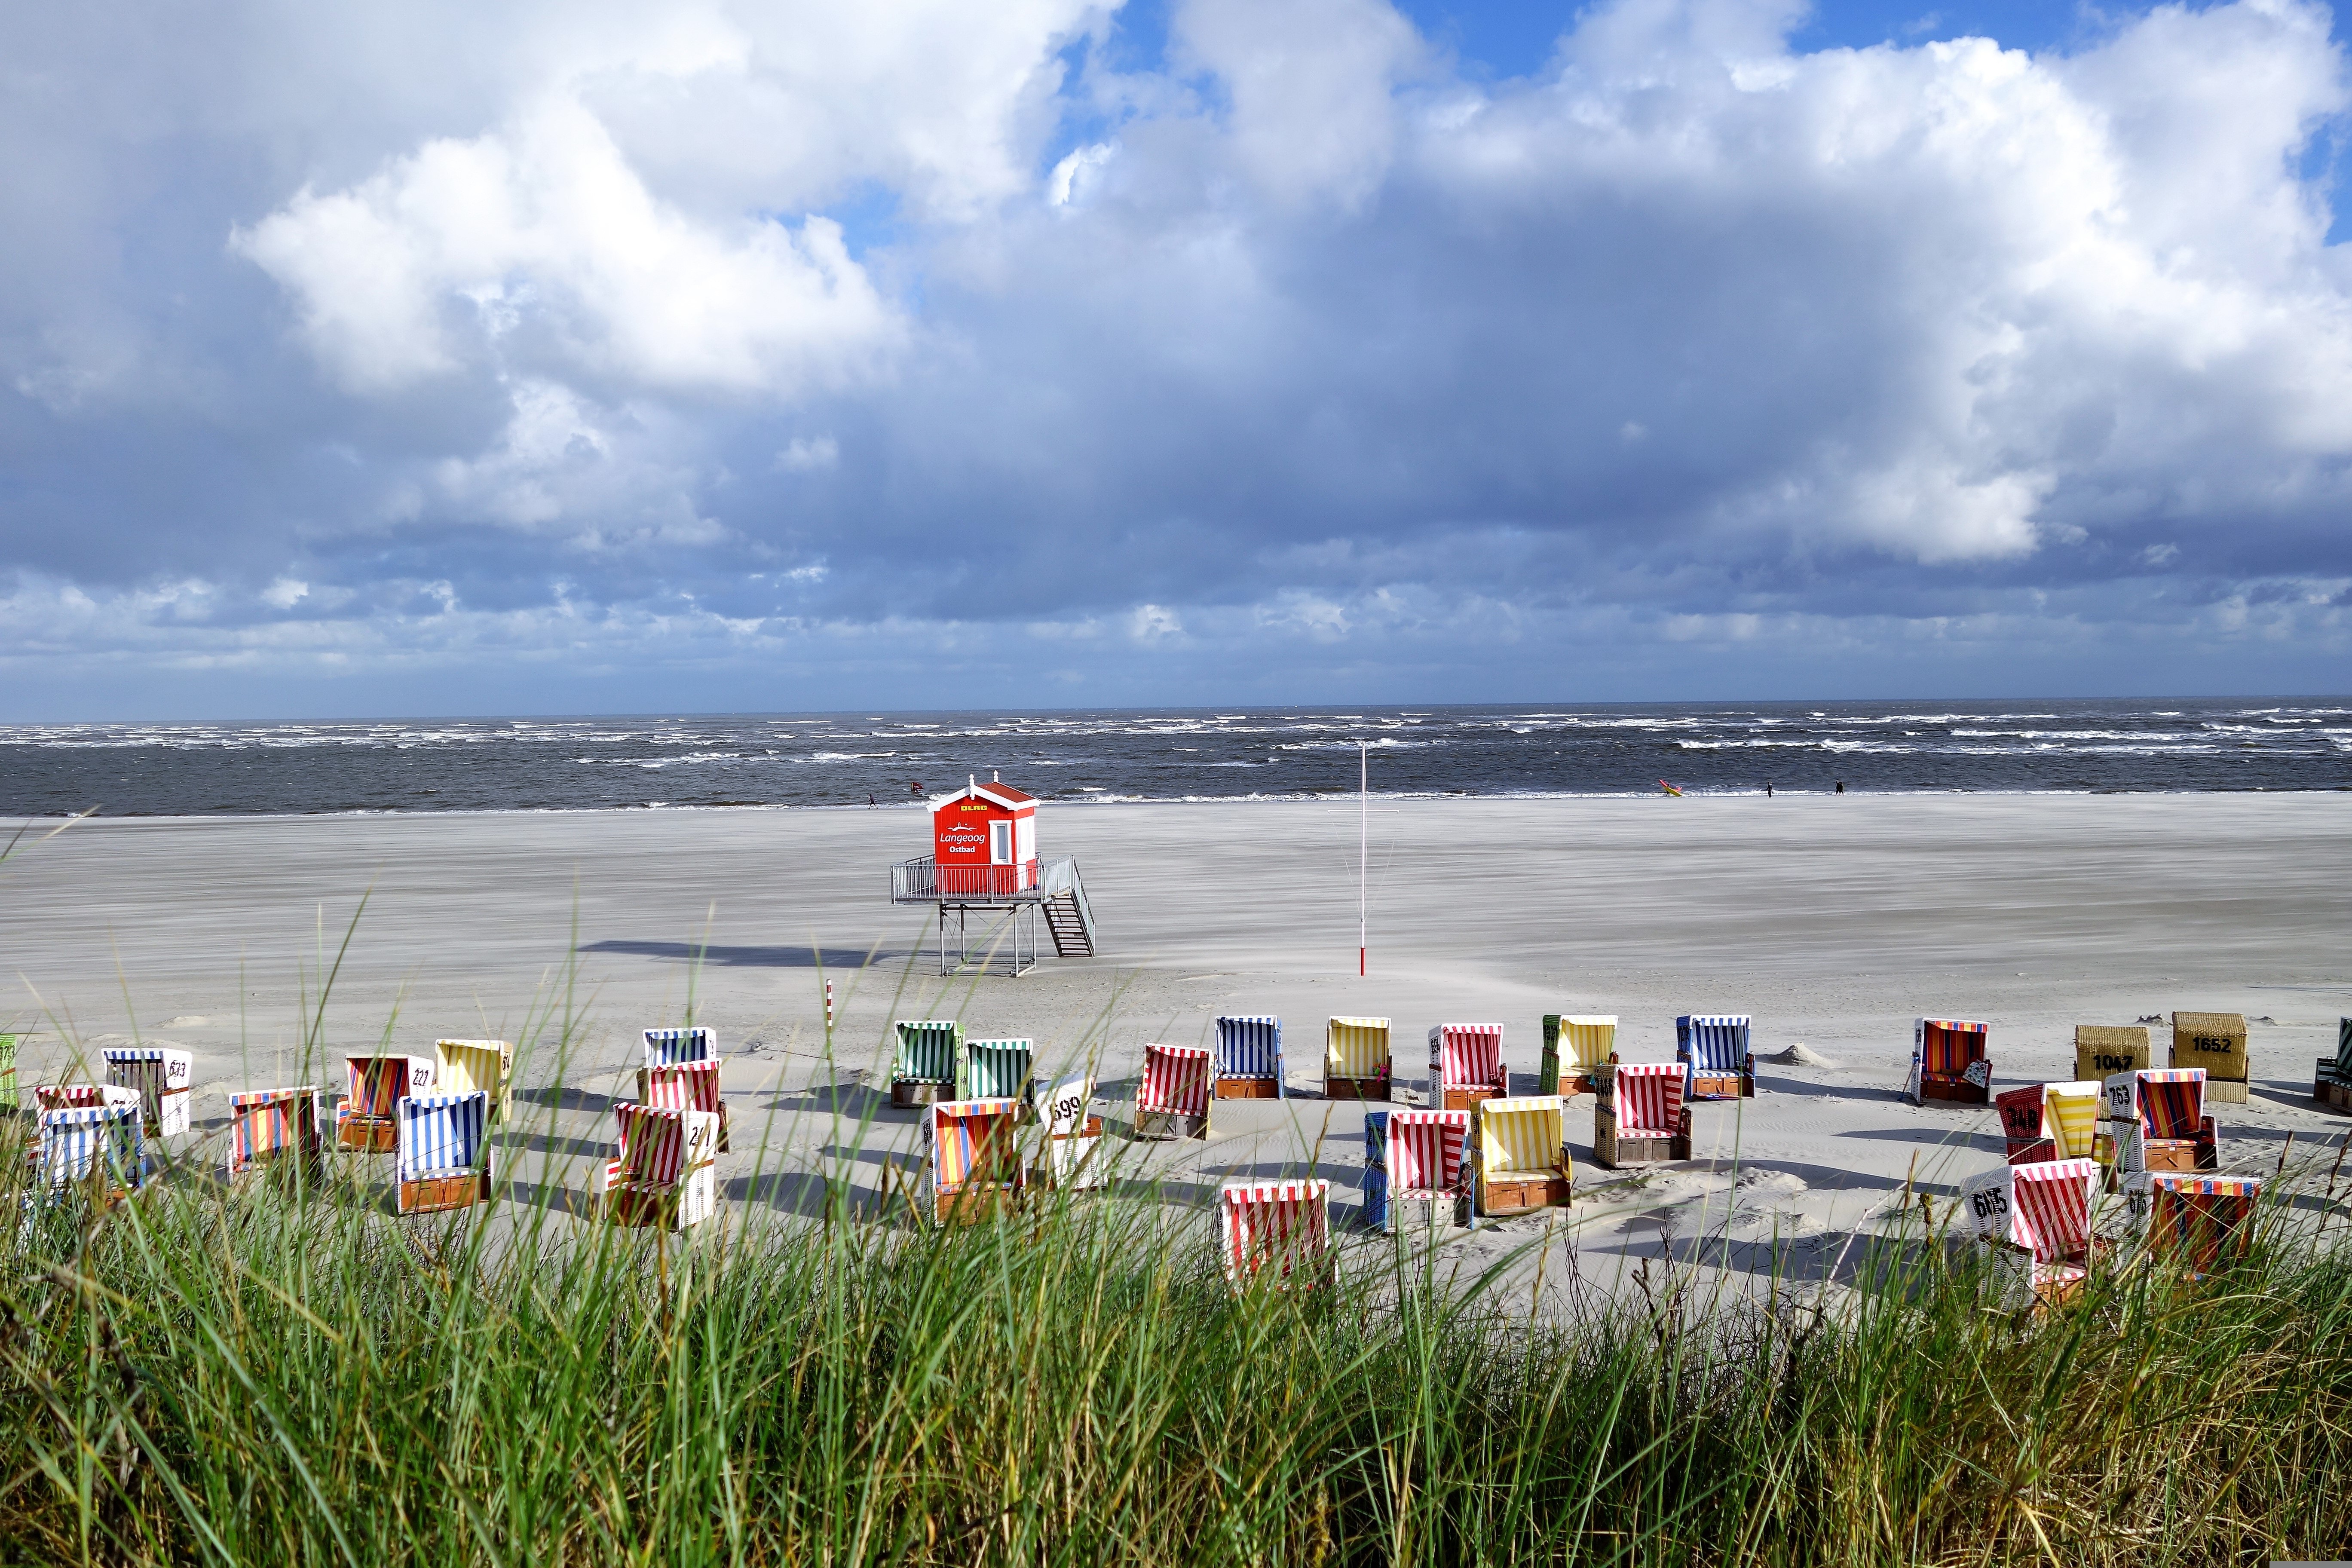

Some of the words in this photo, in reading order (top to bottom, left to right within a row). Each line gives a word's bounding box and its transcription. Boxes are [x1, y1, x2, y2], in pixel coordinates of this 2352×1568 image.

[940, 833, 985, 844] Langeoog
[2193, 1037, 2231, 1053] 1652
[2093, 1054, 2133, 1072] 1047
[2109, 1085, 2130, 1106] 763
[2006, 1107, 2038, 1130] 348
